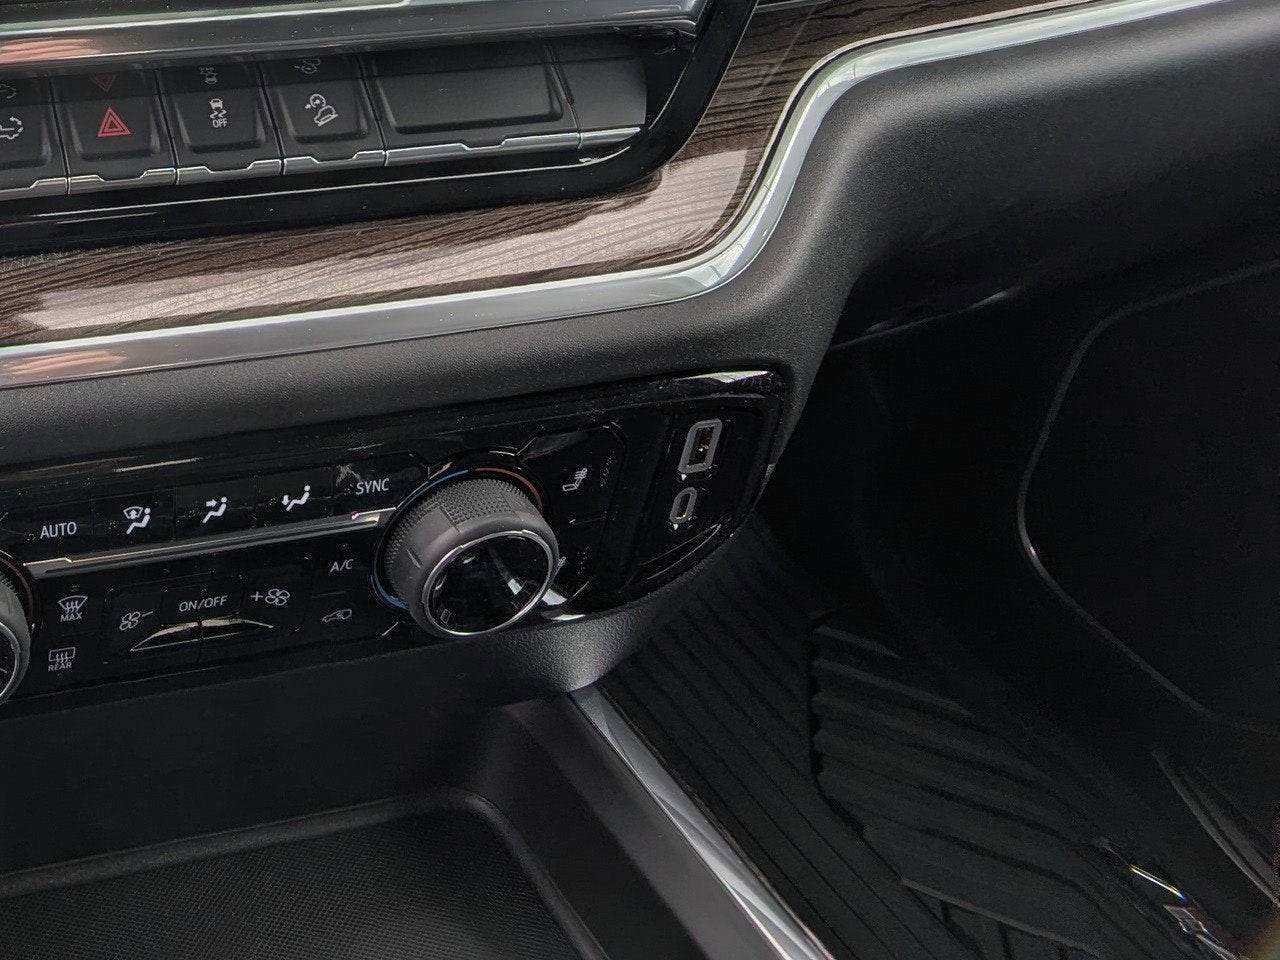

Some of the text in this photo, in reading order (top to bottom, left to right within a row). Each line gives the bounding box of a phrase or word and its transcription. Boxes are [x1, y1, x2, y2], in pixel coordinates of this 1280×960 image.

[212, 118, 227, 128] OFF
[355, 478, 390, 496] SYNC
[39, 521, 77, 540] AUTO
[330, 557, 354, 574] A/C
[178, 595, 228, 612] ON/OFF
[60, 611, 83, 623] MAX
[47, 661, 72, 672] REAR
